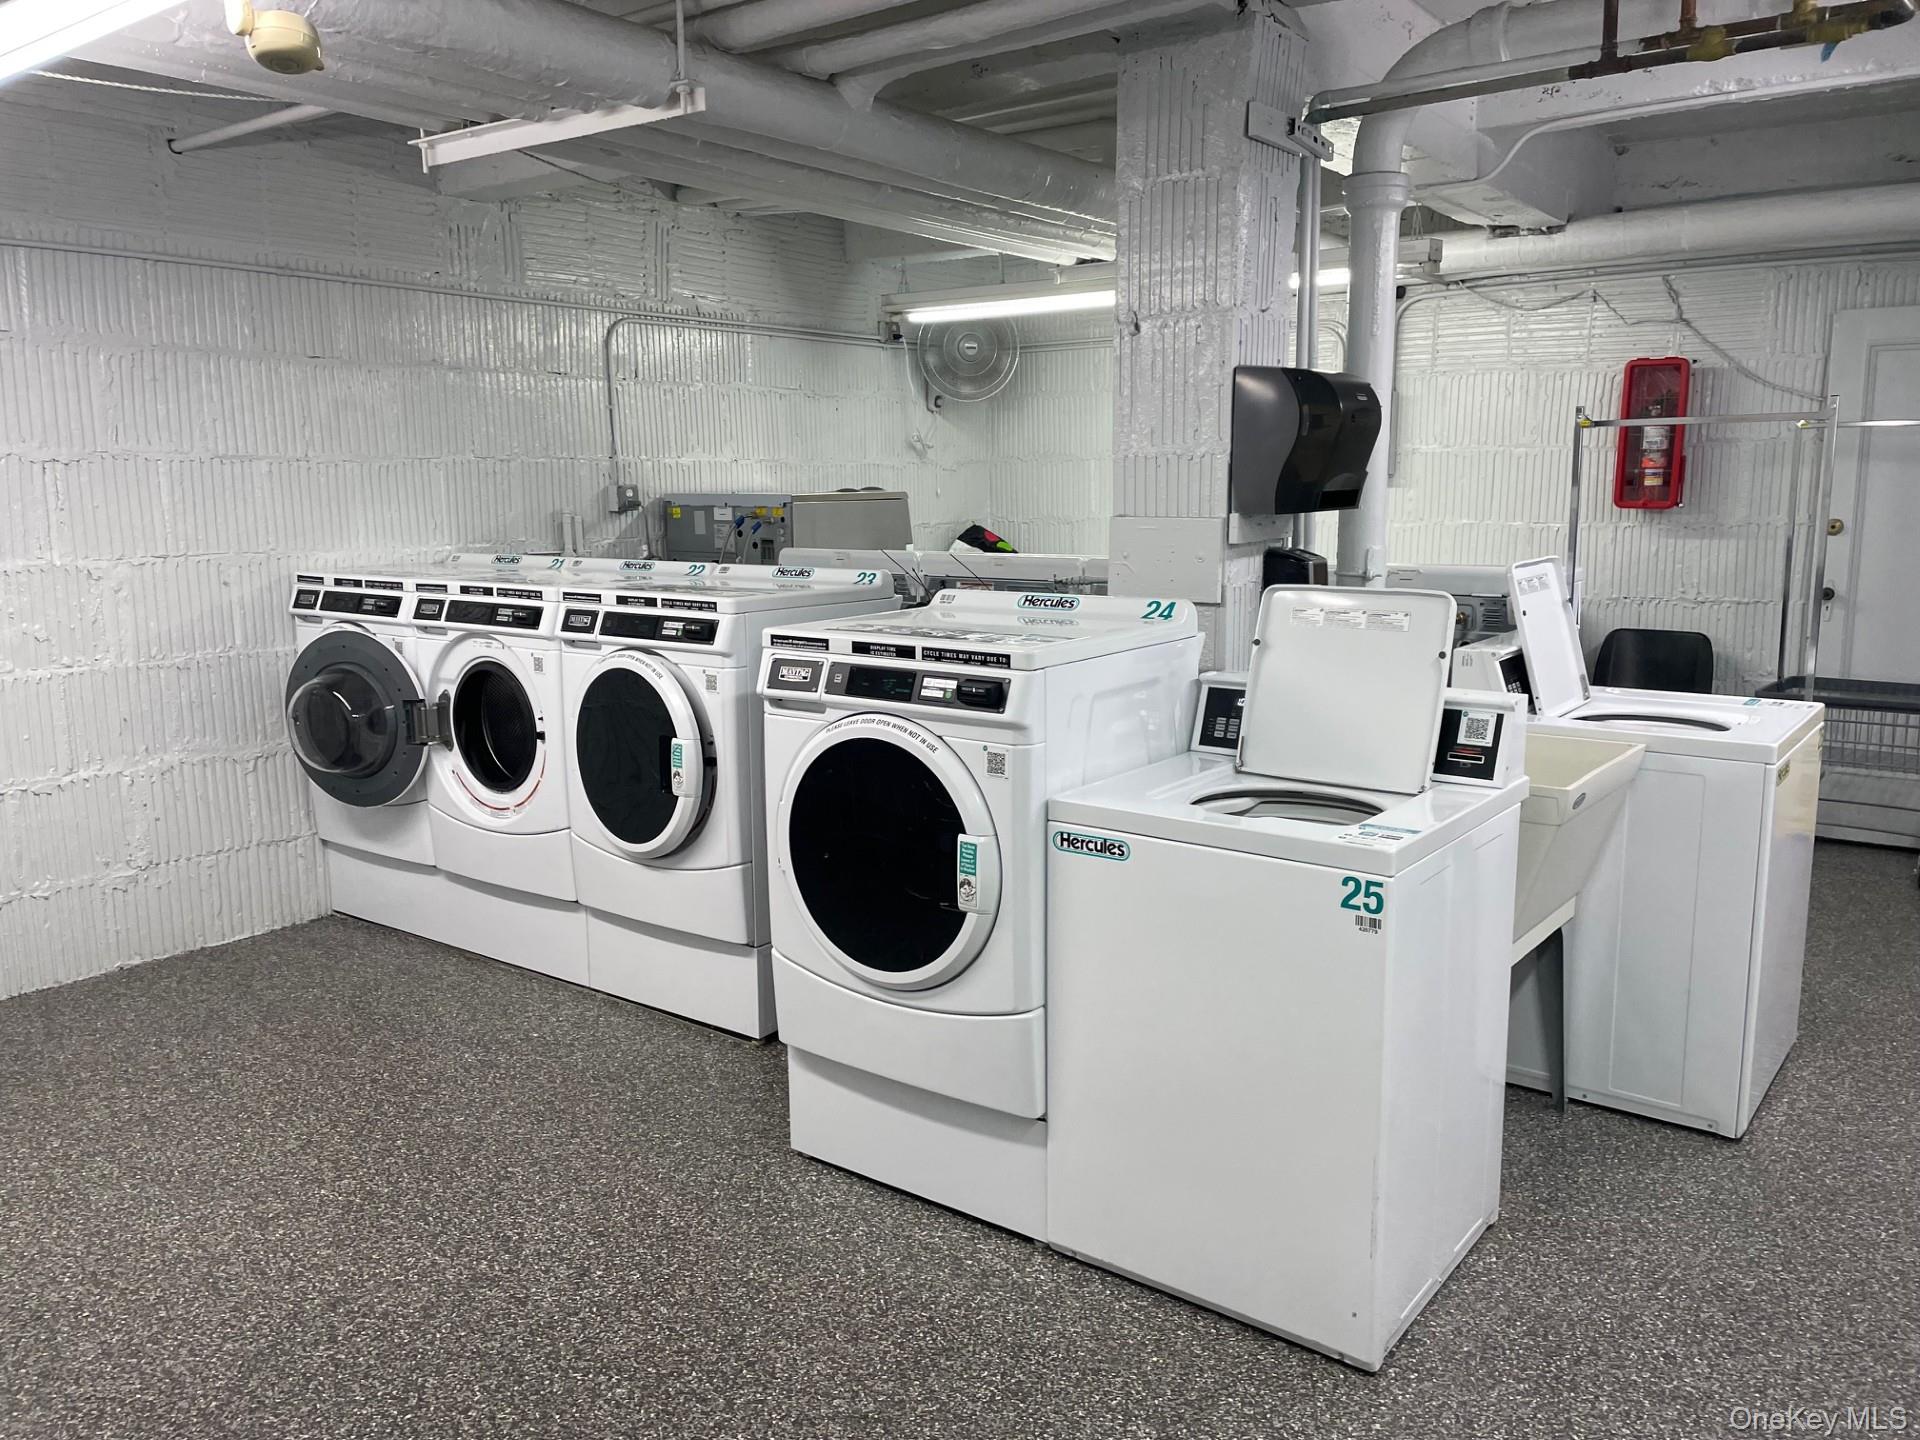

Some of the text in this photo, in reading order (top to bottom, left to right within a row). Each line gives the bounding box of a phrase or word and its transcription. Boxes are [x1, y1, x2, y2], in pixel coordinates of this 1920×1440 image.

[547, 559, 565, 569] 21
[622, 561, 653, 570] Hercules
[686, 565, 705, 575] 22
[776, 567, 814, 578] Hercules
[855, 572, 877, 584] 23
[1023, 595, 1076, 610] Hercules
[1141, 600, 1177, 620] 24
[826, 723, 843, 733] PLEASE
[844, 718, 859, 727] LEAVE
[876, 719, 891, 727] OPEN
[891, 723, 908, 733] WHEN
[908, 730, 921, 740] NOT
[920, 737, 928, 745] IN
[926, 742, 939, 754] USE
[1059, 832, 1126, 857] Hercules
[1341, 876, 1384, 915] 25
